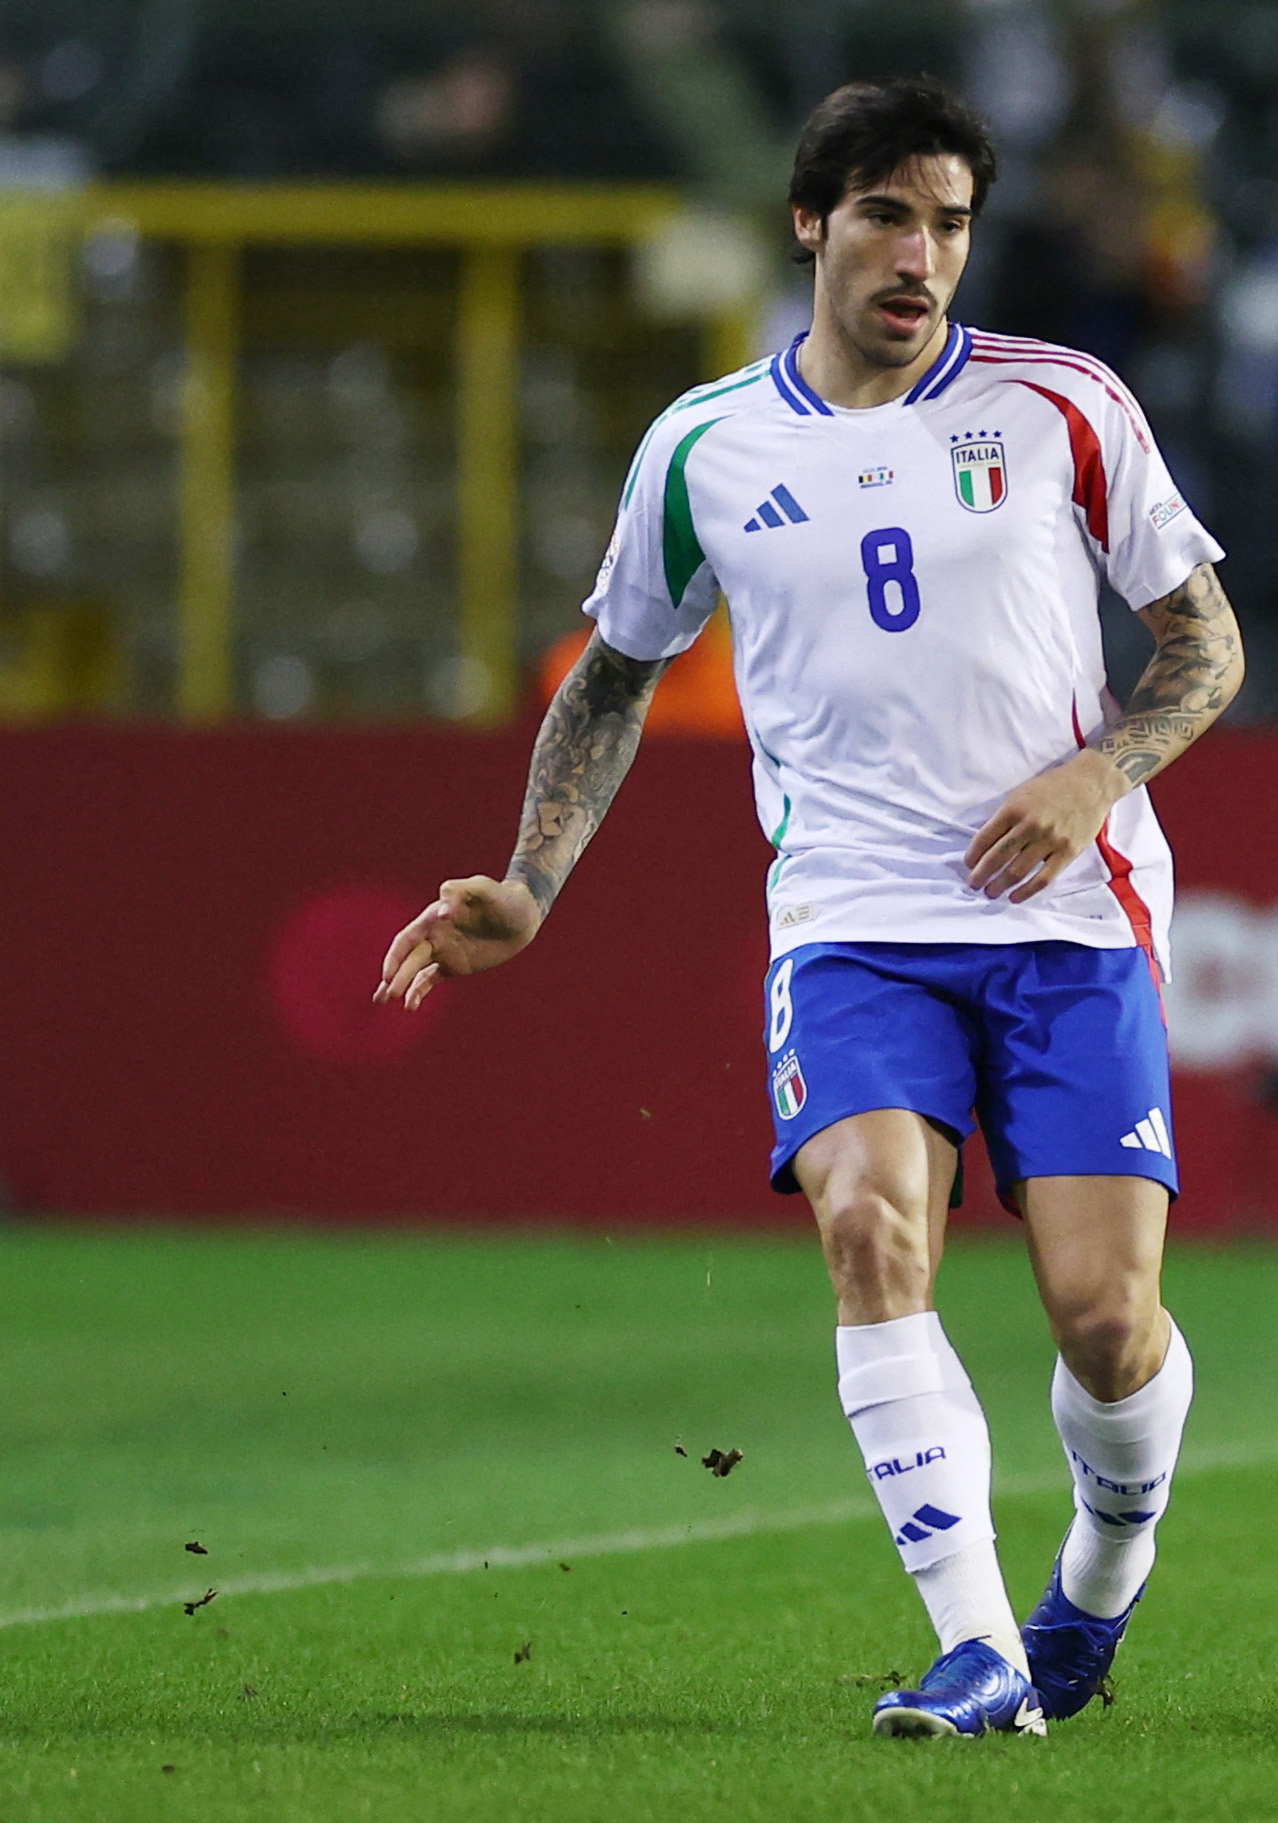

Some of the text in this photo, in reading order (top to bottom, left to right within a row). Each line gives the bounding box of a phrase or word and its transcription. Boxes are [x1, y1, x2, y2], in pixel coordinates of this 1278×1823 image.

[956, 446, 1000, 464] ITALIA
[860, 527, 920, 632] 8
[769, 957, 794, 1054] 8
[1072, 1450, 1166, 1496] ITALIA
